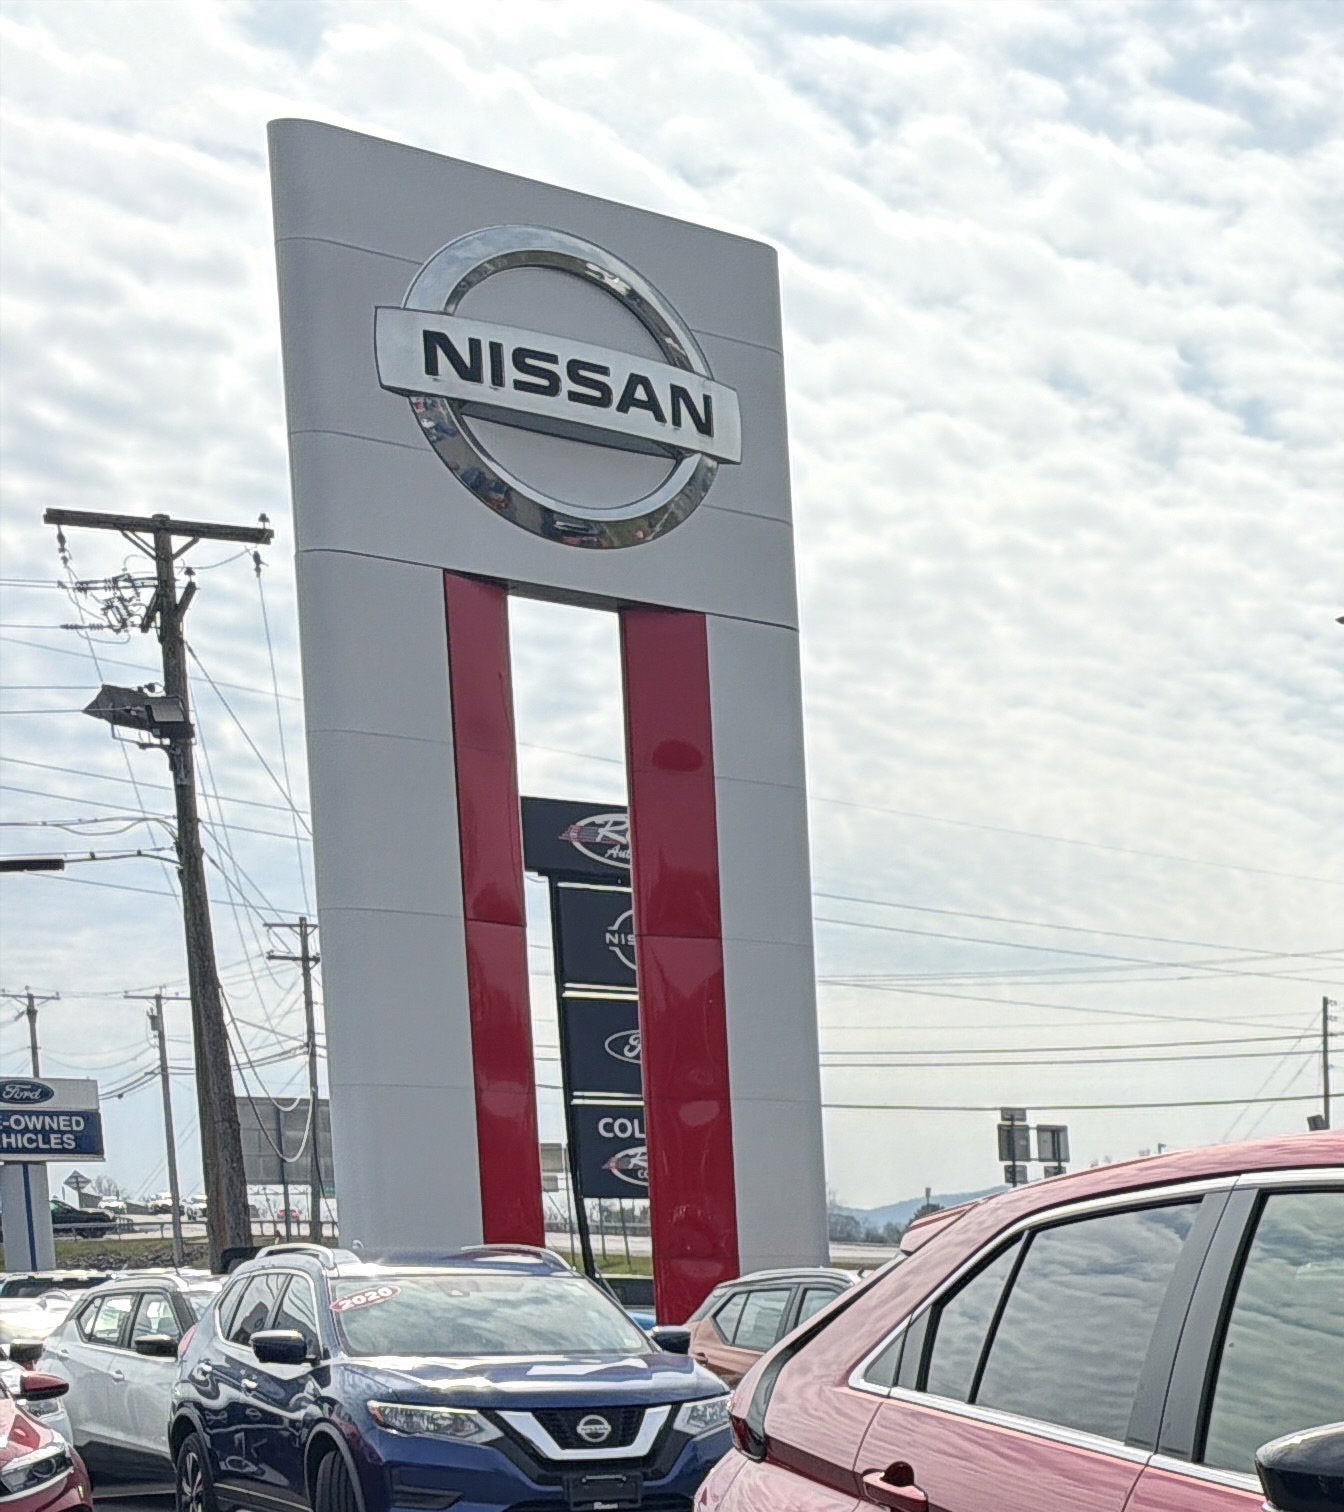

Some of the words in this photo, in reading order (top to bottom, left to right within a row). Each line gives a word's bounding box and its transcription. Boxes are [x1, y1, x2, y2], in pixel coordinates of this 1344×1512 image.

[422, 329, 715, 439] NISSAN
[2, 1083, 42, 1100] Ford
[0, 1114, 85, 1131] -OWNED
[338, 1286, 393, 1311] 2020
